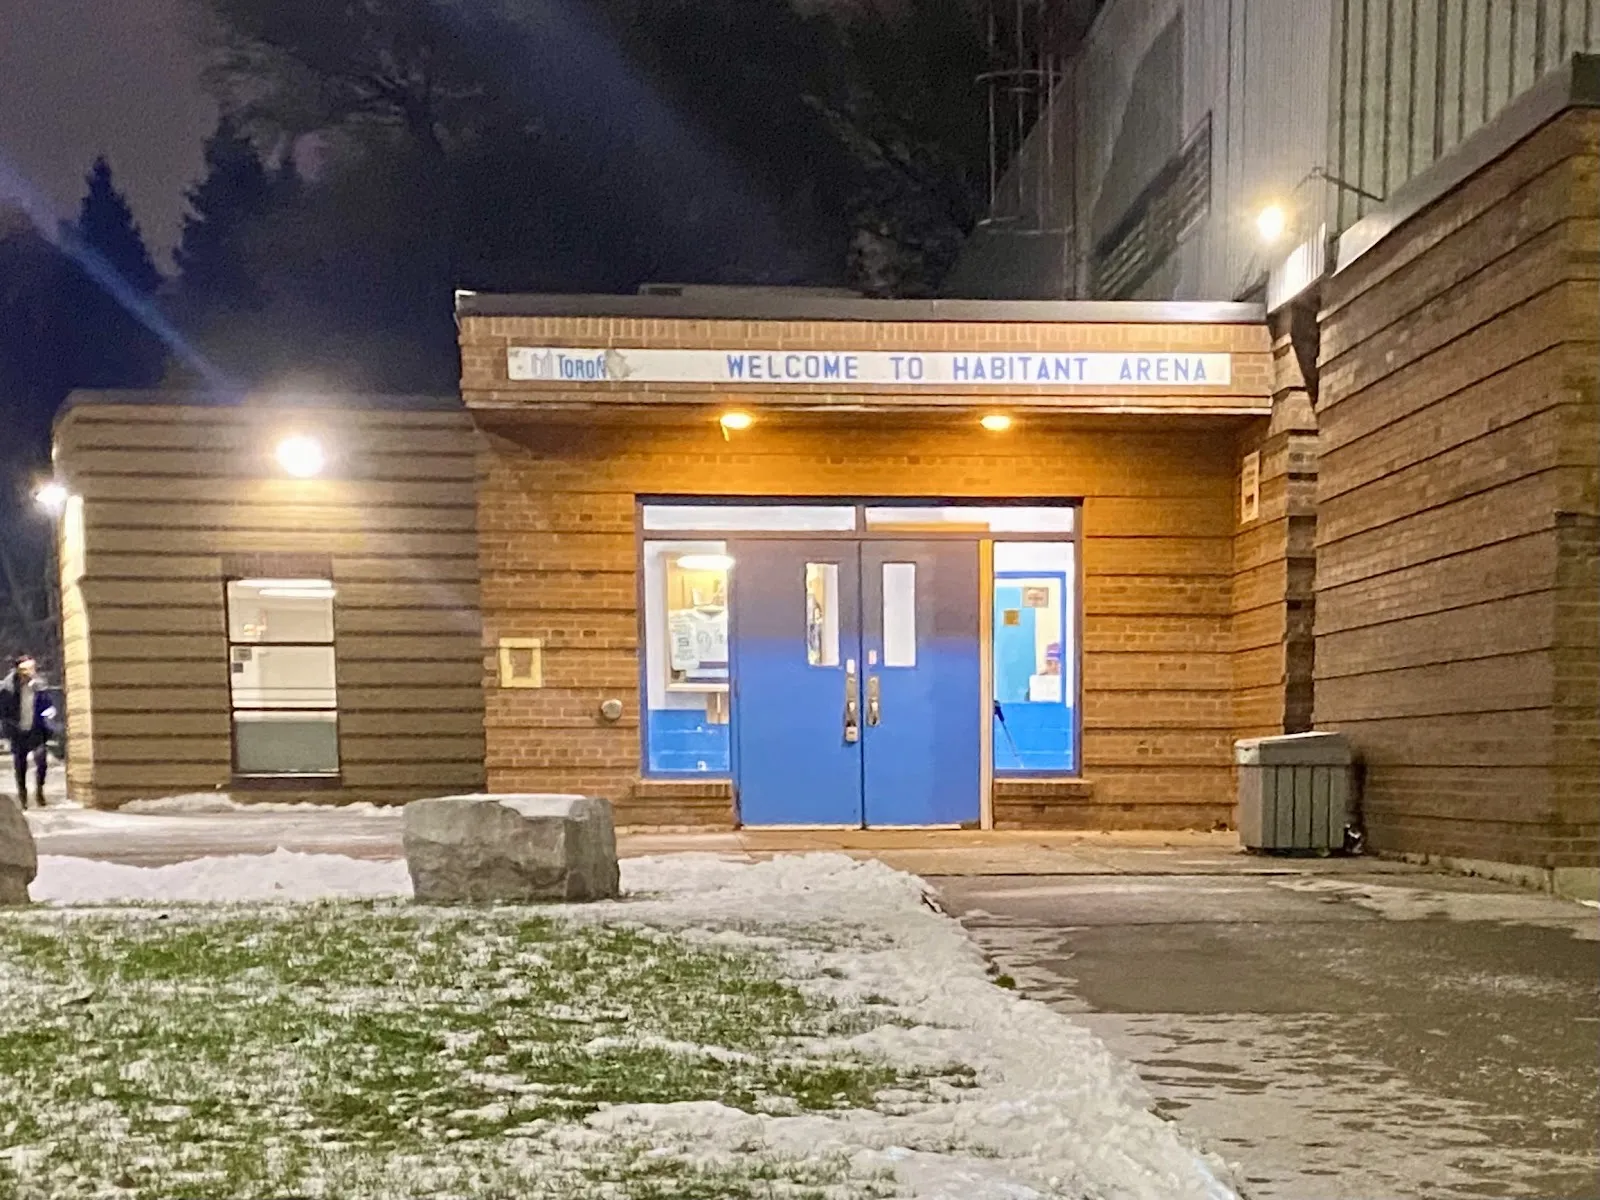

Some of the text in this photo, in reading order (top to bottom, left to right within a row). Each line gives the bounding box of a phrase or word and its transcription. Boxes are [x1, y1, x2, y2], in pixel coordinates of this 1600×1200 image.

[727, 354, 1208, 381] WELCOME TO HABITANT ARENA
